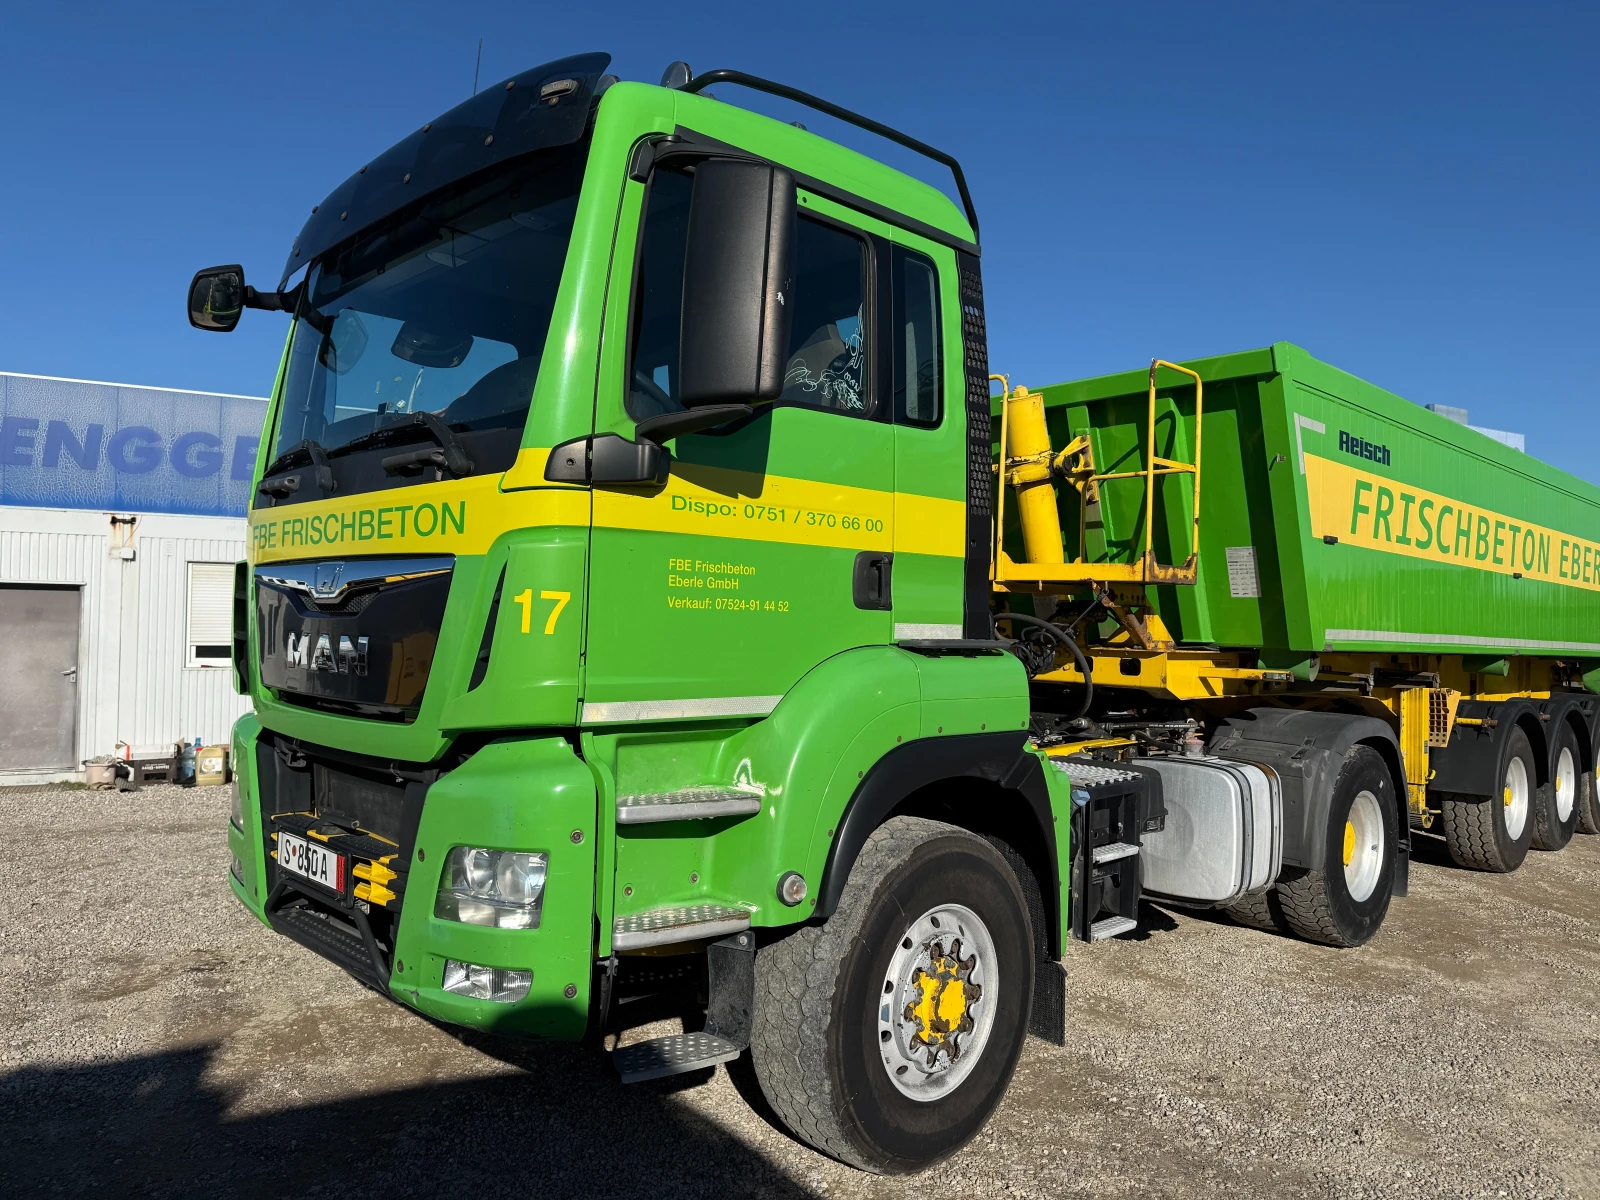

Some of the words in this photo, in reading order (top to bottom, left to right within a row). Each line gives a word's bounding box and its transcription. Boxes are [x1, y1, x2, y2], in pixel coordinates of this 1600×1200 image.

[1339, 430, 1391, 466] Reisch
[253, 521, 277, 550] FBE
[281, 500, 466, 548] FRISCHBETON
[671, 494, 737, 517] Dispo:
[744, 504, 786, 523] 0751
[793, 510, 801, 524] /
[806, 511, 837, 528] 370
[841, 515, 861, 530] 66
[865, 518, 884, 533] 00
[1350, 478, 1551, 575] FRISCHBETON
[668, 574, 704, 588] Eberle
[706, 576, 739, 590] GmbH
[669, 558, 692, 572] FBE
[695, 560, 756, 576] Frischbeton
[514, 588, 571, 635] 17
[667, 595, 712, 610] Verkauf:
[715, 598, 761, 611] 07524-91
[763, 600, 776, 611] 44
[777, 601, 789, 612] 52
[287, 632, 369, 677] MAN
[284, 838, 291, 865] S
